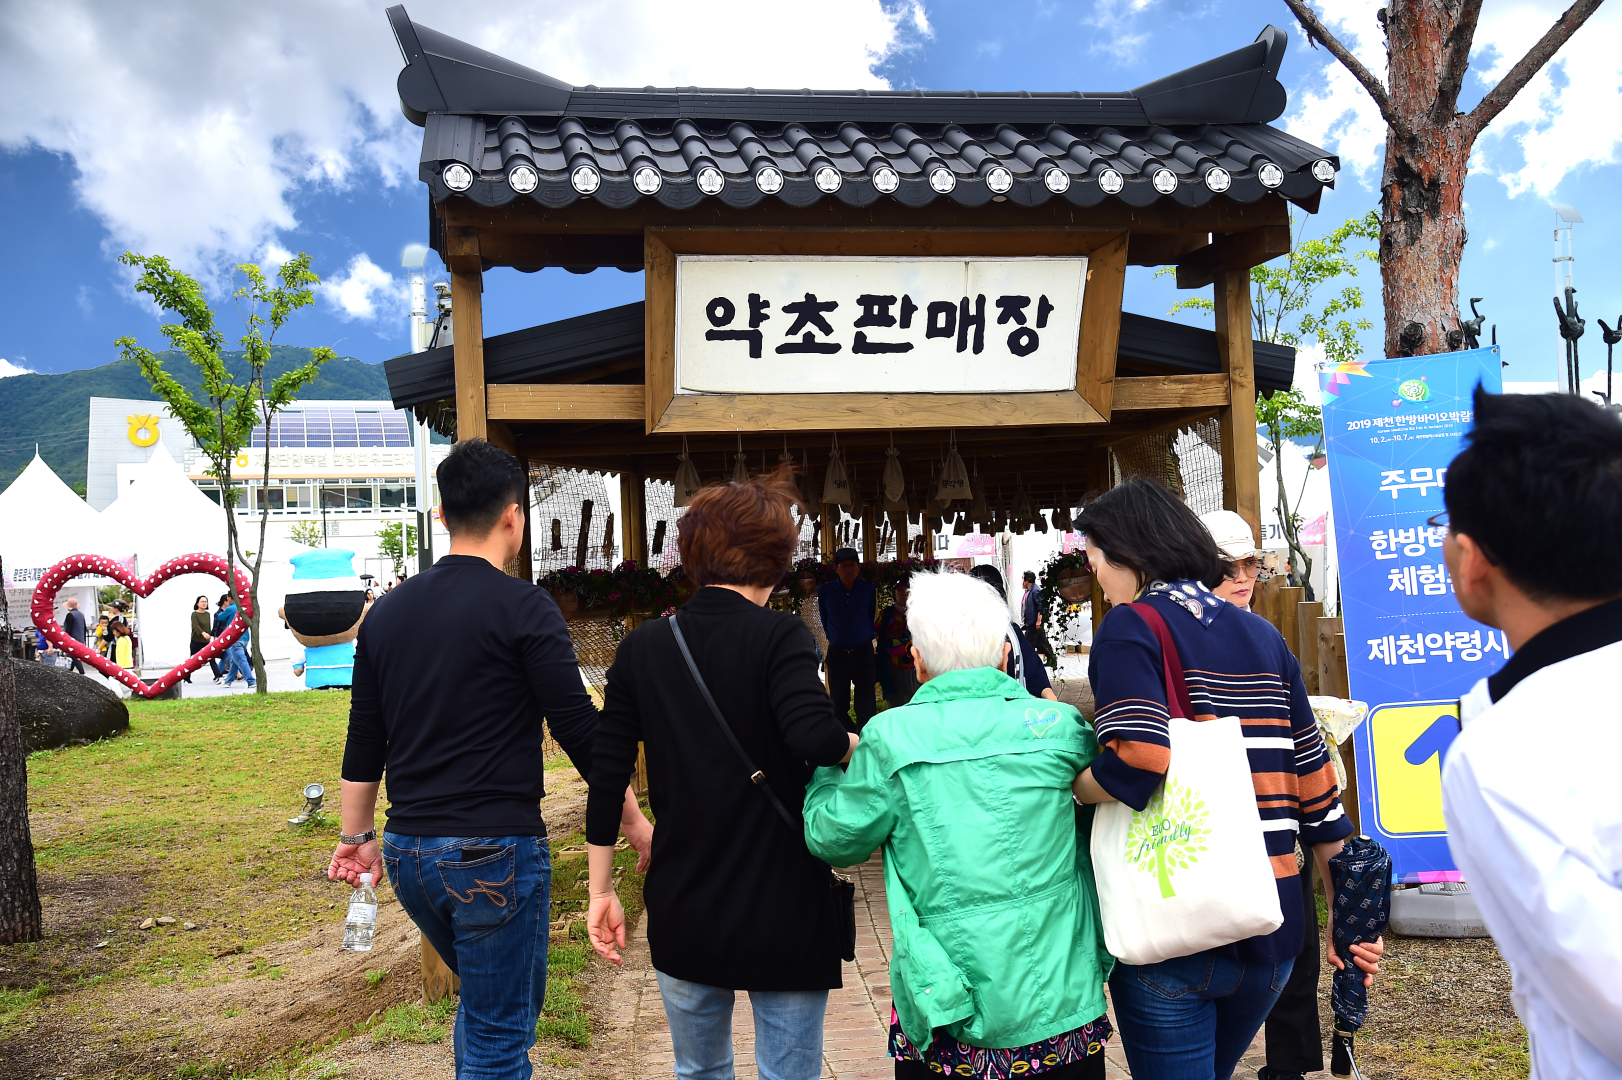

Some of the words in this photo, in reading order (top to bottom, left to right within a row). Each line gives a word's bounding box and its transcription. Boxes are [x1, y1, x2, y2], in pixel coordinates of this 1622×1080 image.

[705, 292, 1055, 359] 약초판매장
[1346, 419, 1371, 431] 2019
[1379, 467, 1448, 500] 주무
[1387, 563, 1455, 596] 체험
[1133, 821, 1194, 862] friendly
[1151, 818, 1171, 837] ECO
